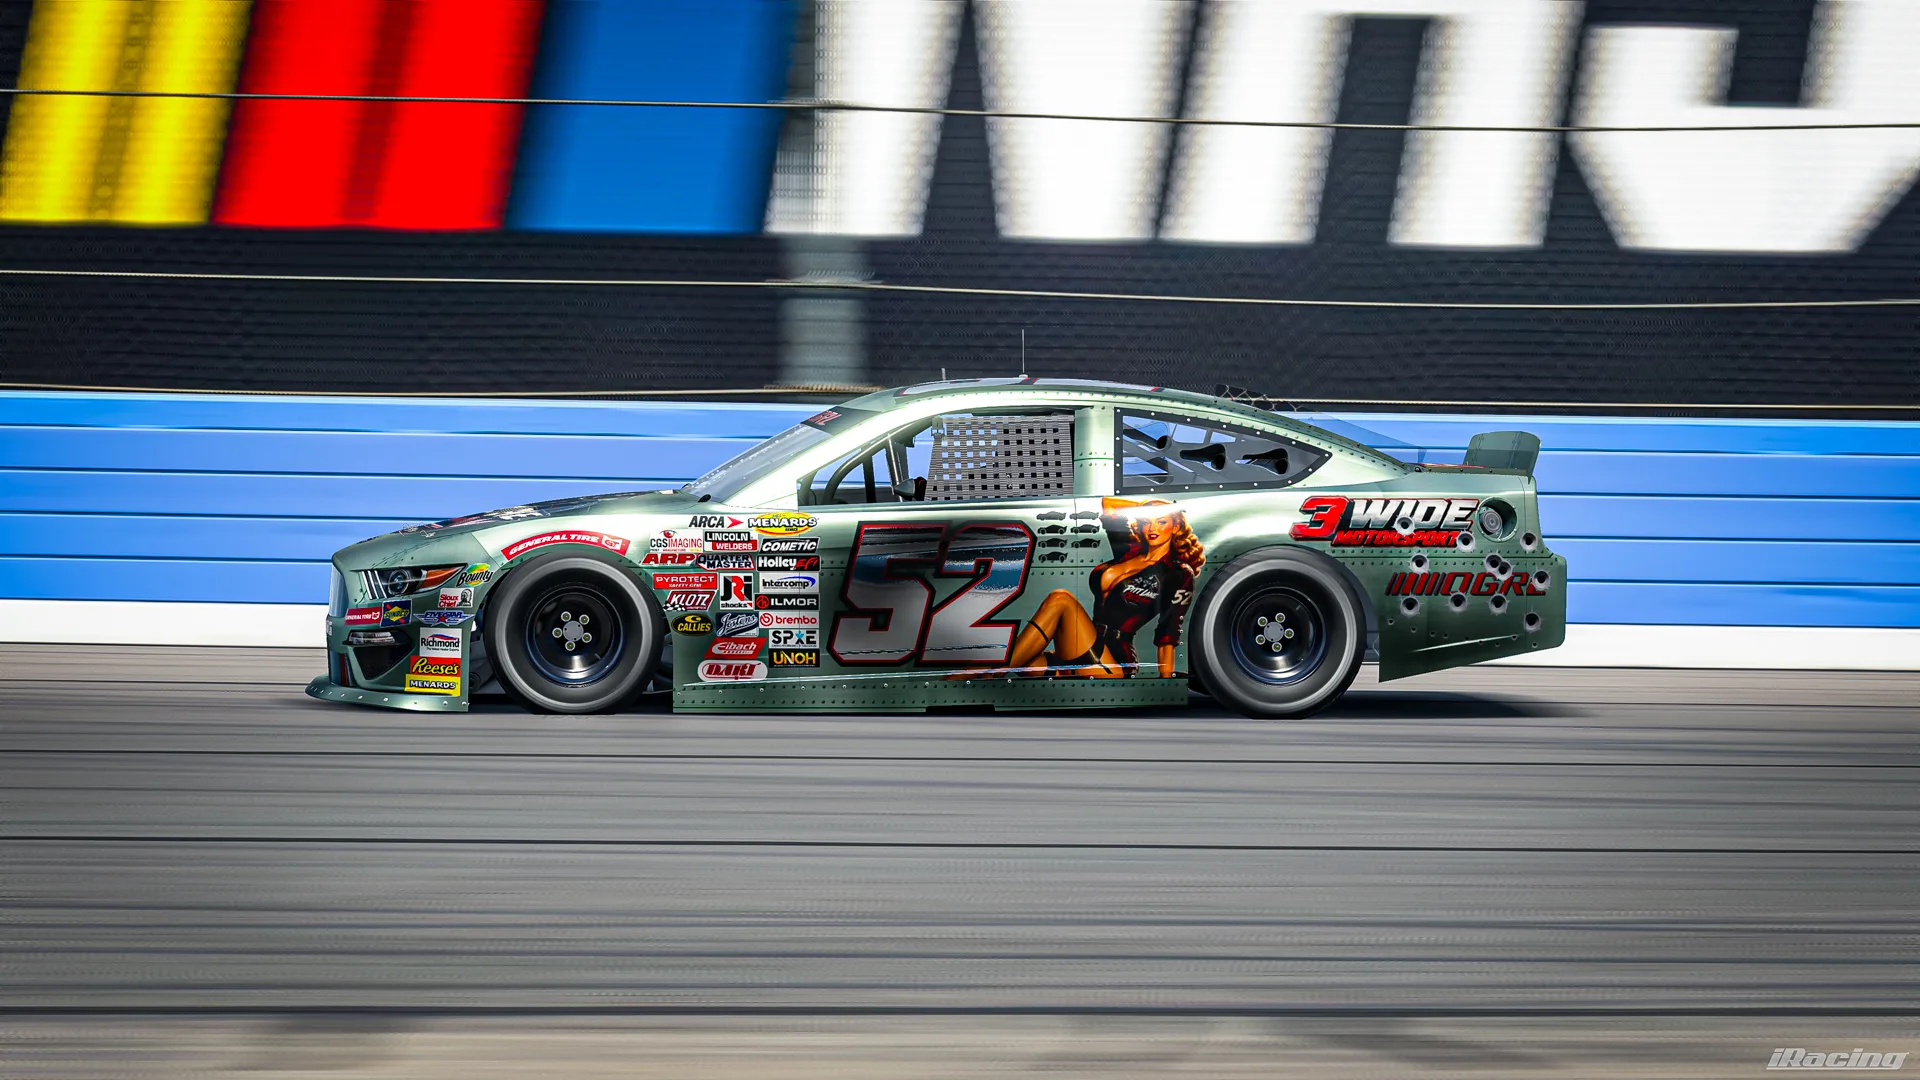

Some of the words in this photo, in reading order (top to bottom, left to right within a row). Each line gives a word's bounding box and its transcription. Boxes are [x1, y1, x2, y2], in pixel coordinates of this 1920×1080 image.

[689, 516, 724, 528] ARCA
[748, 518, 817, 527] MENARDS
[1289, 496, 1350, 541] 3
[1349, 498, 1479, 530] WIDE
[706, 533, 748, 541] LINCOLN
[509, 534, 568, 555] GENERAL
[570, 534, 599, 542] TIRE
[762, 540, 816, 551] COMETIC
[641, 553, 696, 564] ARP
[698, 555, 749, 564] QUARTER
[758, 557, 797, 570] Holley
[456, 571, 493, 586] Bounty
[762, 579, 809, 589] Intercomp
[828, 521, 1036, 665] 52
[1171, 590, 1193, 605] 52
[670, 594, 710, 606] KLOTZ
[770, 598, 816, 606] ILMOR
[776, 616, 817, 624] brembo
[678, 623, 711, 632] CALLIES
[420, 638, 460, 648] Richmond
[712, 642, 757, 654] Eibach
[773, 651, 816, 664] UNOH
[412, 657, 460, 675] Reese's
[705, 664, 759, 676] DART
[410, 680, 455, 689] MENARDS
